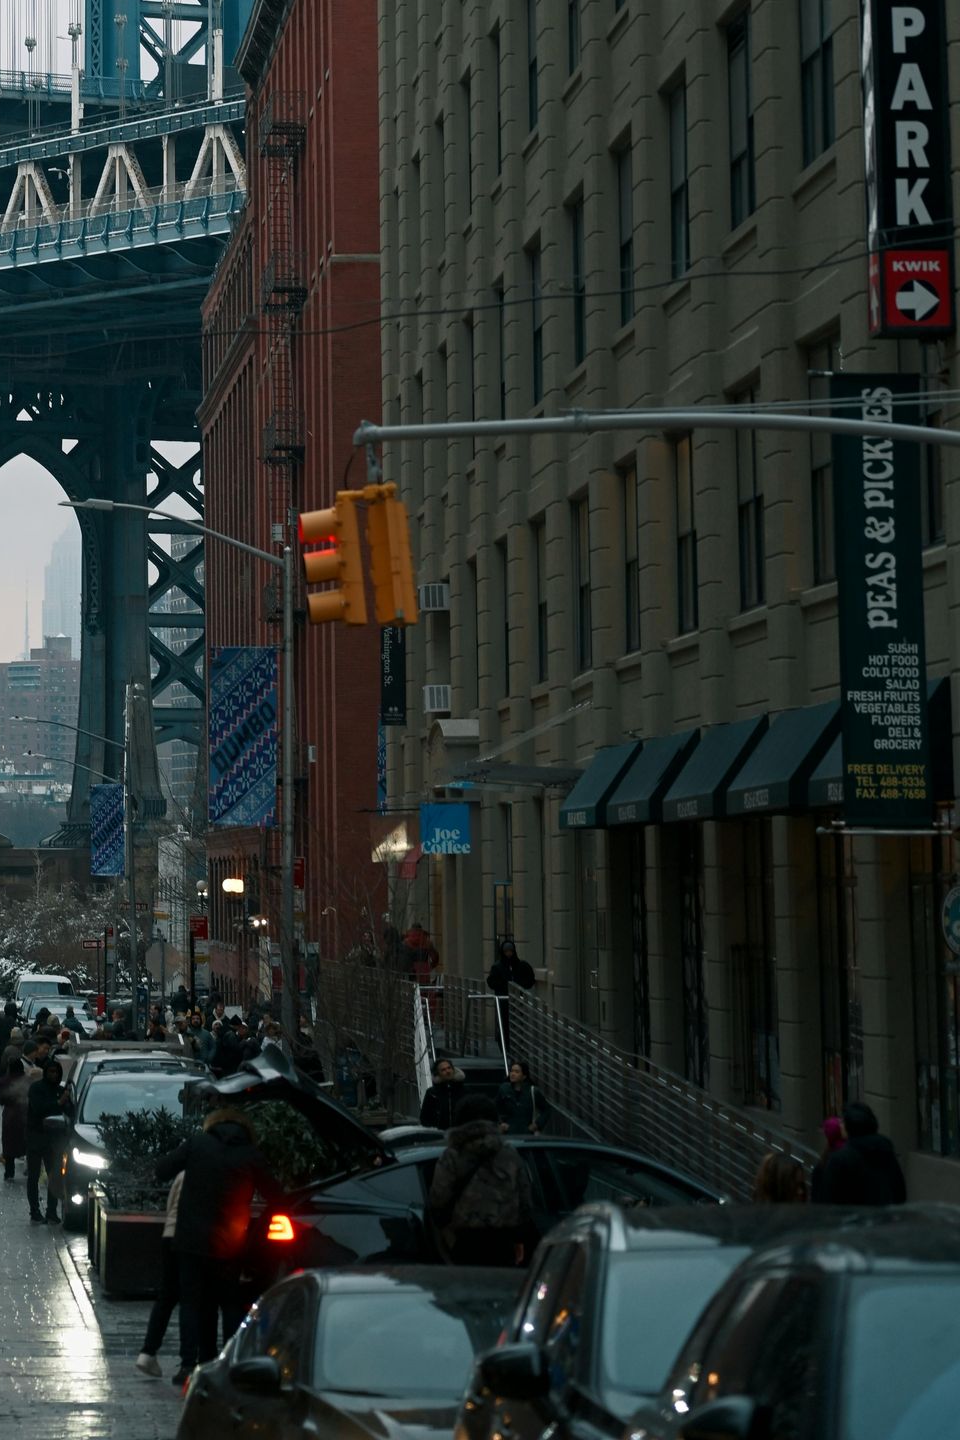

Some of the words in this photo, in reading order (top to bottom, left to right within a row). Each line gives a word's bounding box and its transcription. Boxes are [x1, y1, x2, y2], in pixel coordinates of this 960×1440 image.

[890, 6, 933, 226] PARK
[892, 260, 941, 272] KWIK
[861, 385, 895, 512] PICKES
[863, 516, 897, 544] &
[866, 552, 898, 630] PEAS
[887, 643, 919, 654] SUSHI
[868, 655, 889, 666] HOT
[891, 655, 919, 666] FOOD
[862, 667, 890, 678] COLD
[891, 667, 920, 678] FOOD
[885, 679, 920, 690] SALAD
[847, 690, 882, 702] FRESH
[884, 690, 921, 702] FRUITS
[854, 702, 921, 714] VEGETABLES
[871, 714, 921, 726] FLOWERS
[210, 700, 276, 776] DUMBO
[888, 726, 911, 738] DELI
[912, 727, 922, 738] &
[873, 738, 923, 750] GROCERY
[847, 763, 875, 775] FREE
[876, 763, 926, 775] DELIVERY
[855, 775, 878, 787] TEL.
[879, 775, 926, 787] 488-8336
[855, 788, 878, 800] FAX.
[431, 827, 461, 843] Joe
[420, 839, 471, 854] Coffee
